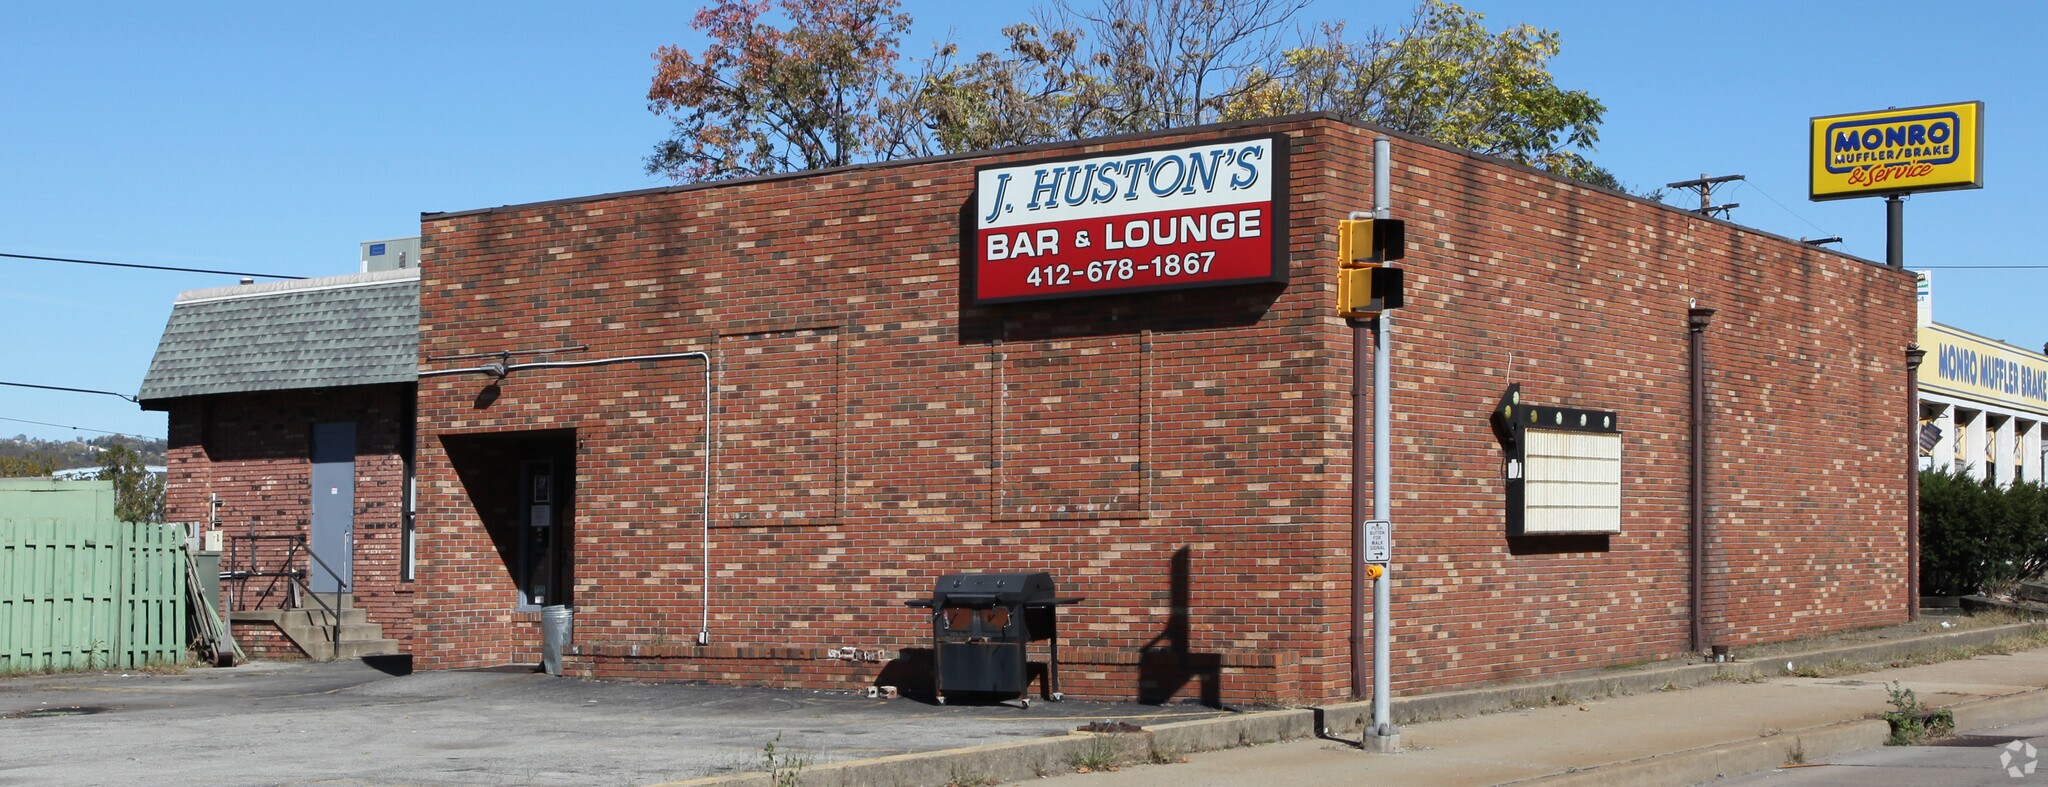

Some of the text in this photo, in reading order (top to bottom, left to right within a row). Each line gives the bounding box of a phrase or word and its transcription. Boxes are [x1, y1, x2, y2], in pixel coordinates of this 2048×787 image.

[1835, 122, 1950, 152] MONRO
[1835, 145, 1949, 164] MUFFLER/BRAKE
[985, 145, 1264, 223] J. HUSTON'S
[987, 209, 1261, 261] BAR & LOUNGE
[1026, 251, 1216, 287] 412-678-1867
[1938, 342, 2047, 402] MONRO MUFFLER BRAKE
